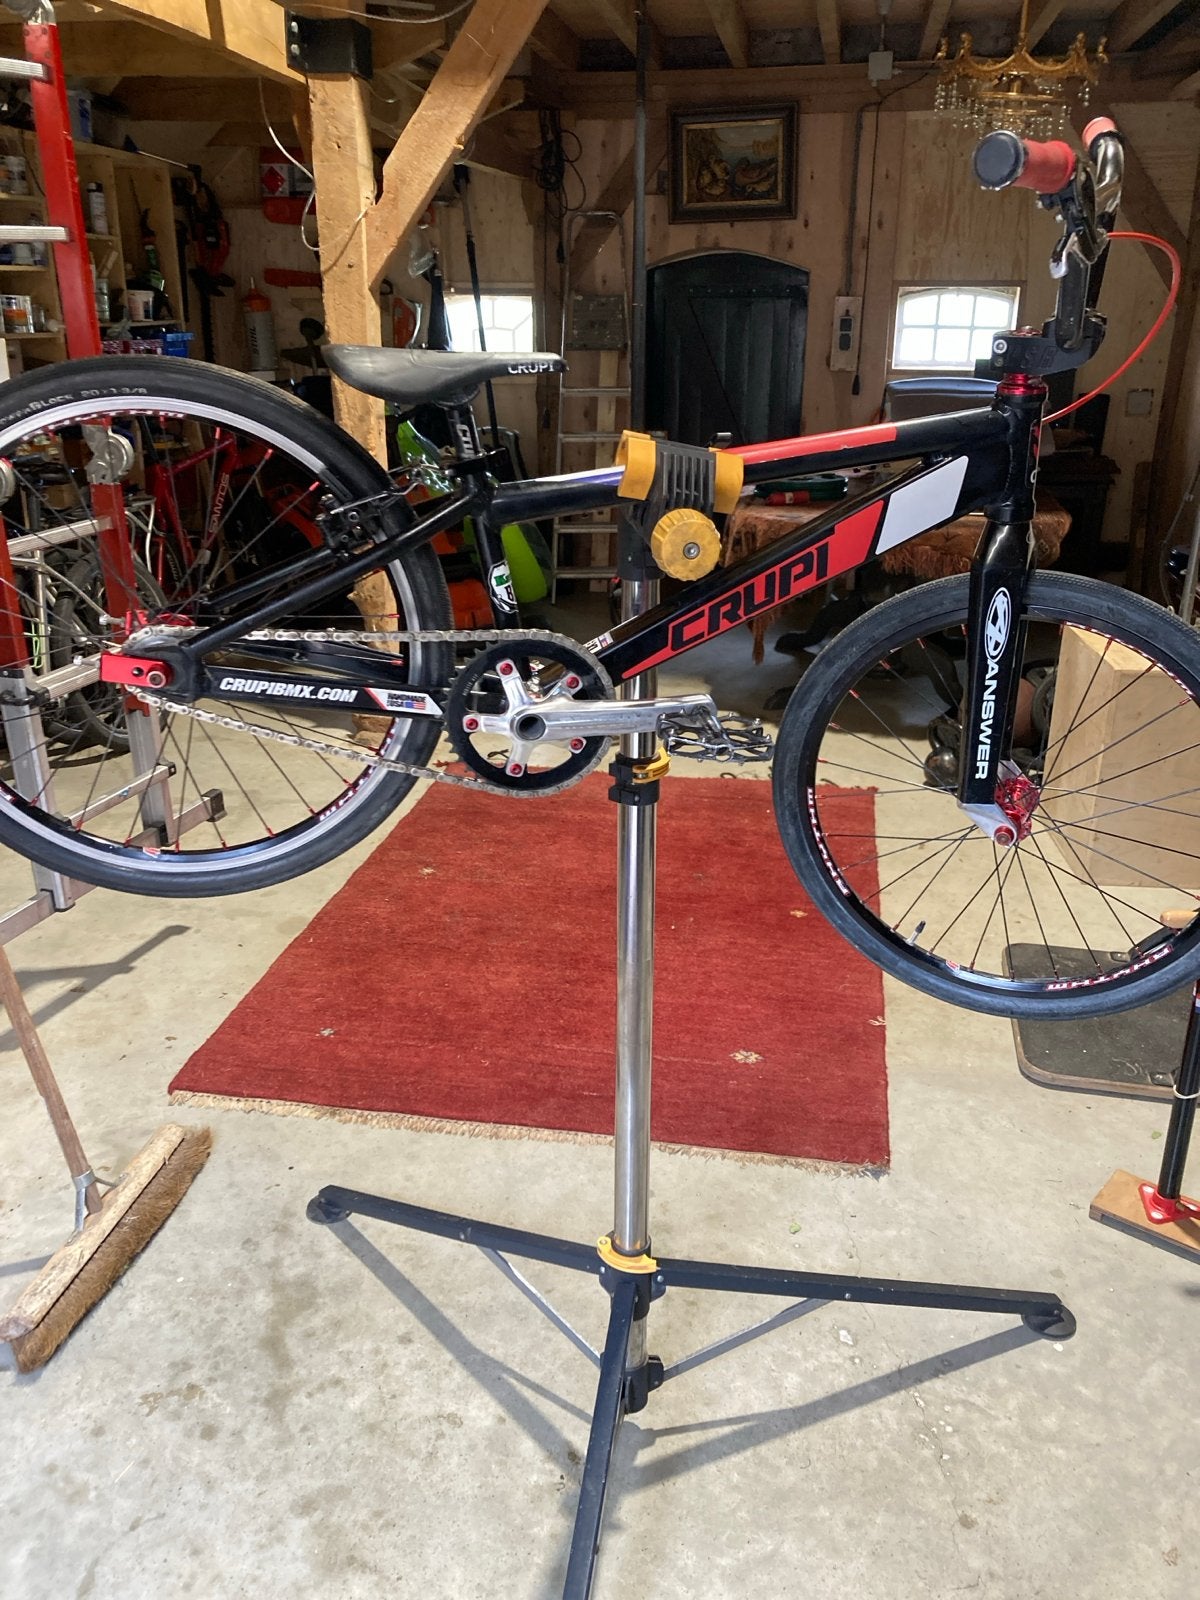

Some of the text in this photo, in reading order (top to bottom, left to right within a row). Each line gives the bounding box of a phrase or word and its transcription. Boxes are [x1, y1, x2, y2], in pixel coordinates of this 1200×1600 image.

[507, 360, 555, 374] CRUPI
[671, 542, 829, 651] CRUPI
[219, 677, 359, 703] CRUPIBMX.COM
[974, 658, 999, 780] ANSWER
